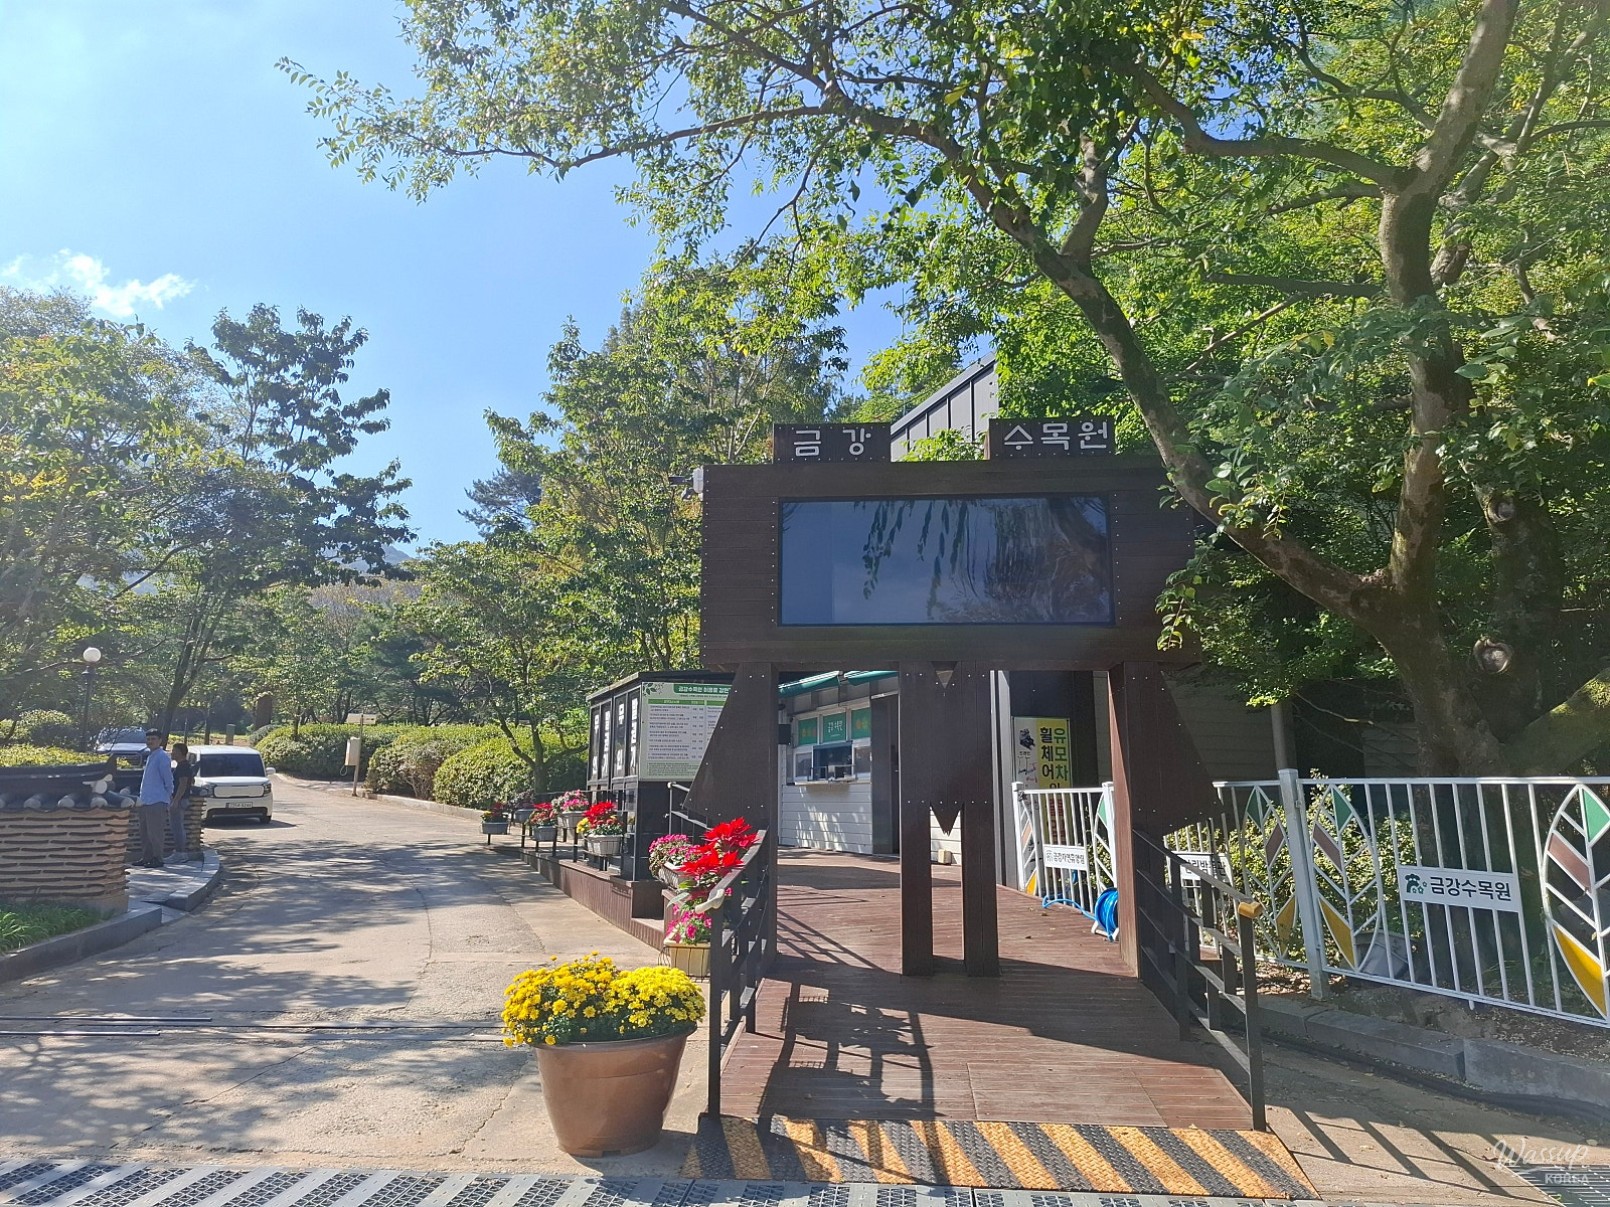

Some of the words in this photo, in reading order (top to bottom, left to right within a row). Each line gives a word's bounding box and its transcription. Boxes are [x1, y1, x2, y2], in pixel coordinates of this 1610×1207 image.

[1003, 420, 1108, 450] 수목원
[1039, 726, 1055, 780] 휠체어
[1053, 727, 1069, 781] 유모차
[1430, 876, 1512, 902] 금강수목원
